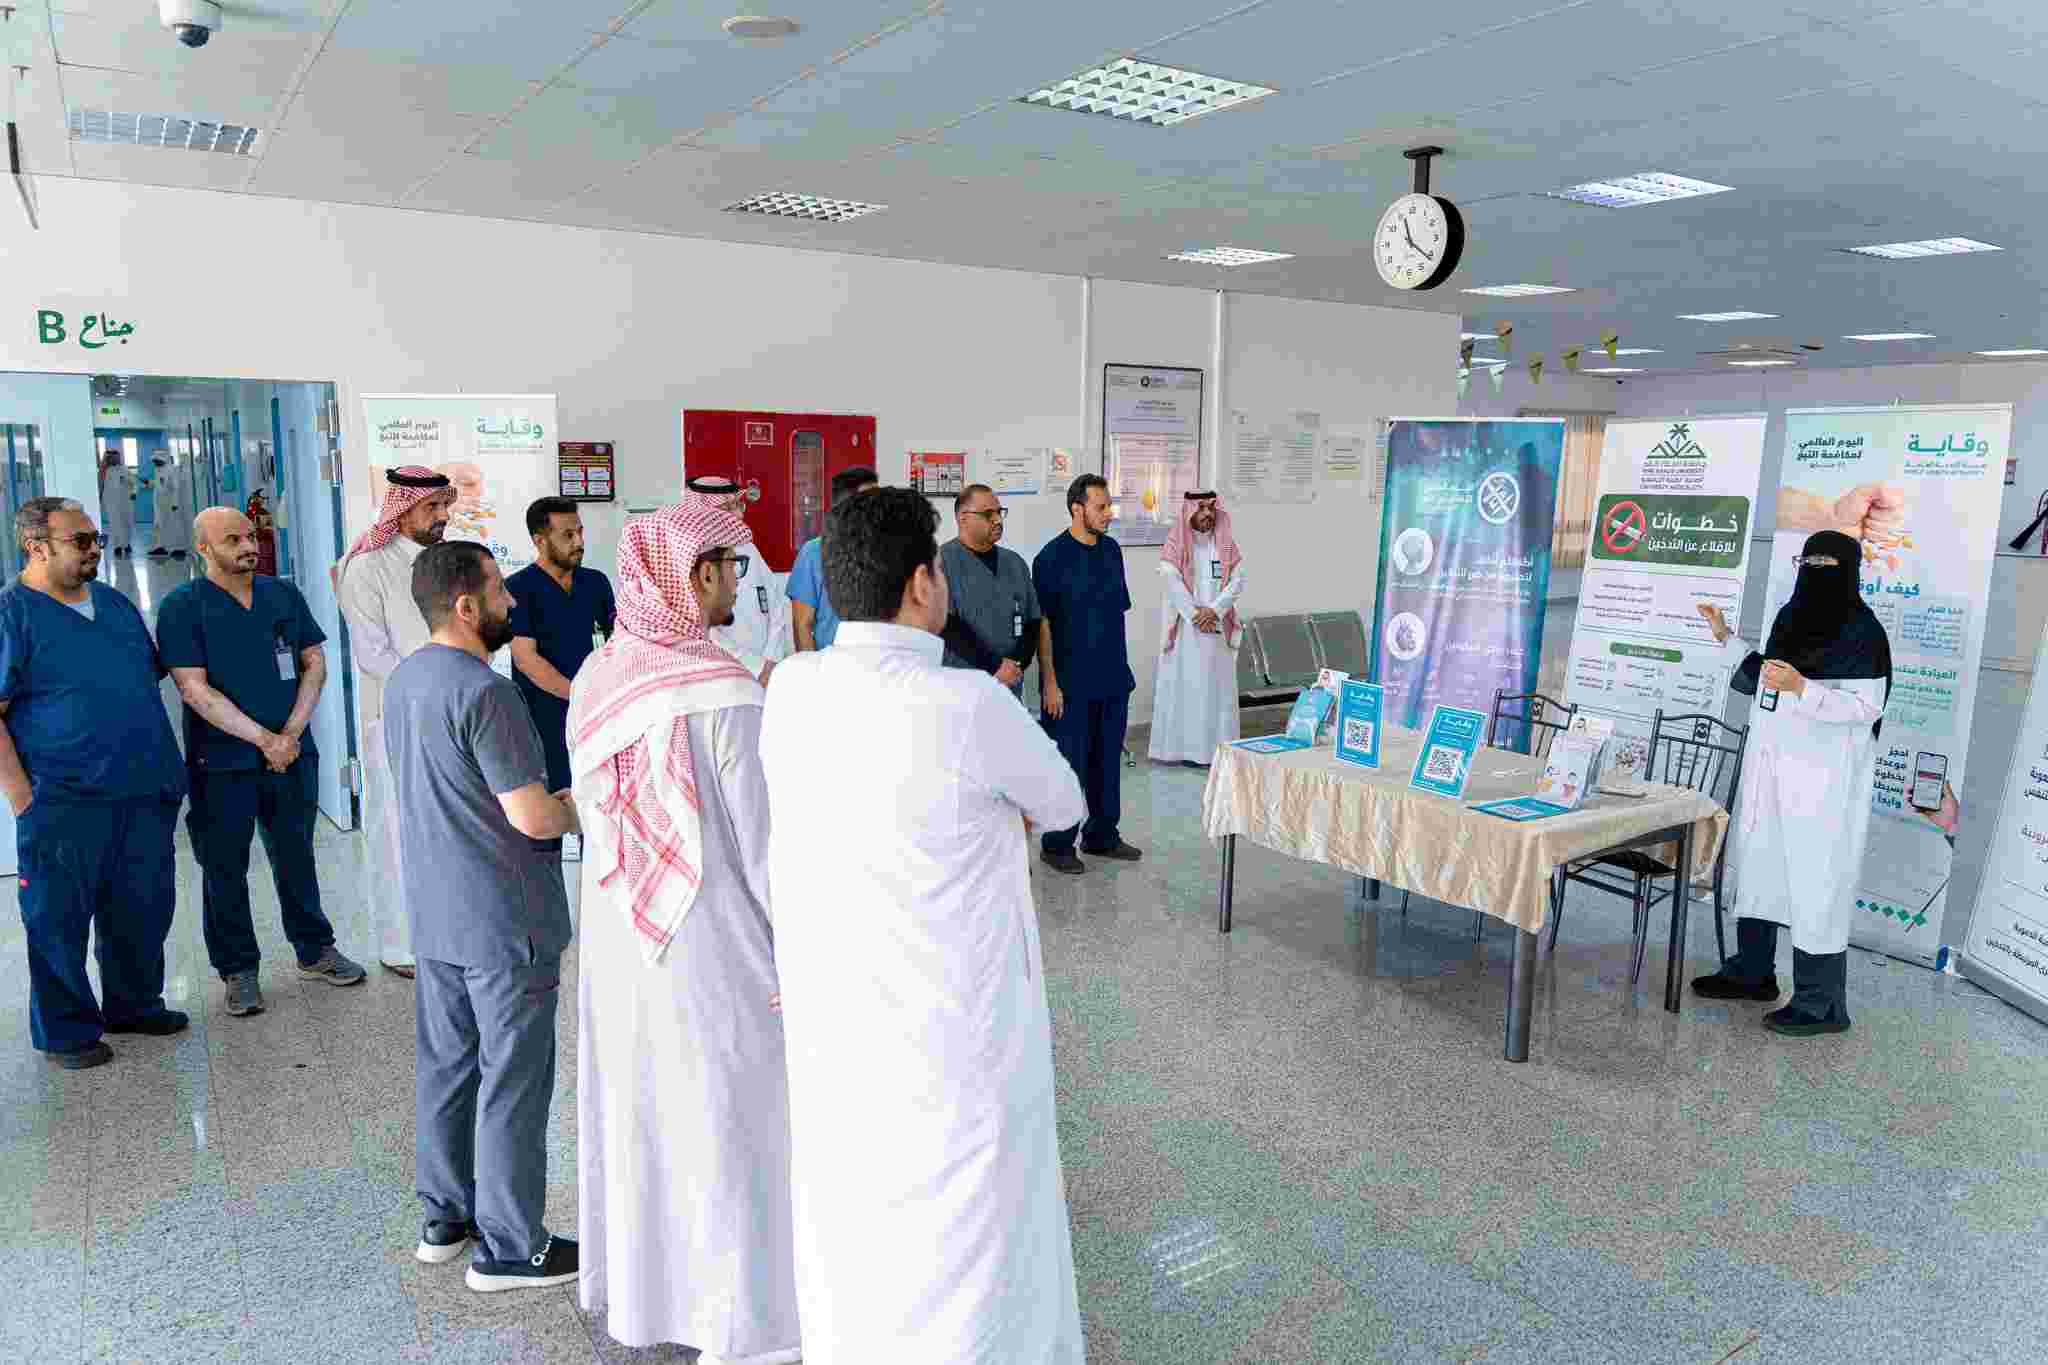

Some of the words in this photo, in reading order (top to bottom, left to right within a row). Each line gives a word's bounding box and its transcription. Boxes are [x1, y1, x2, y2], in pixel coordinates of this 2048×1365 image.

[38, 310, 65, 343] B
[79, 311, 134, 348] جناح
[1907, 431, 1989, 457] وقاية
[1651, 511, 1738, 535] خطوات
